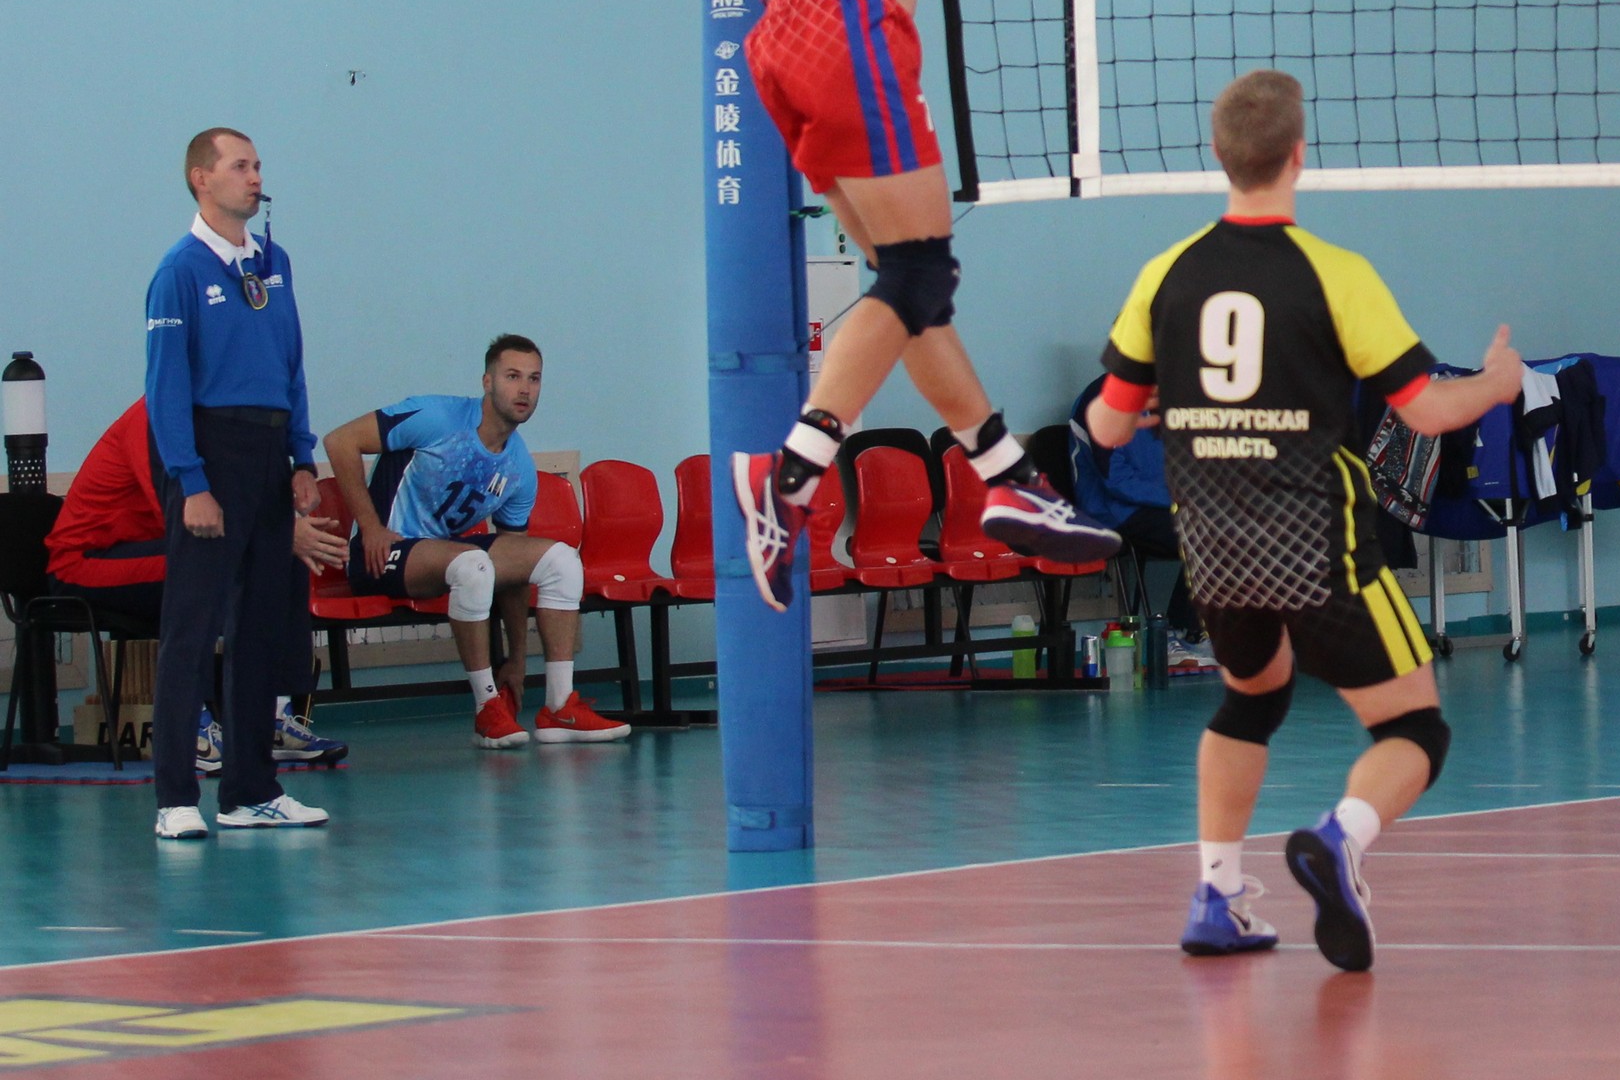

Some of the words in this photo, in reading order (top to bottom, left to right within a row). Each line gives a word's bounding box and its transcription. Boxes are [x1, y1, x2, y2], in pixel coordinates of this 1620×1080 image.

[714, 67, 742, 206] 金陵体育
[1199, 290, 1266, 403] 9
[1165, 407, 1311, 431] ОРЕНБУРГСКАЯ
[1192, 436, 1278, 460] ОБЛАСТЬ
[431, 480, 487, 531] 15
